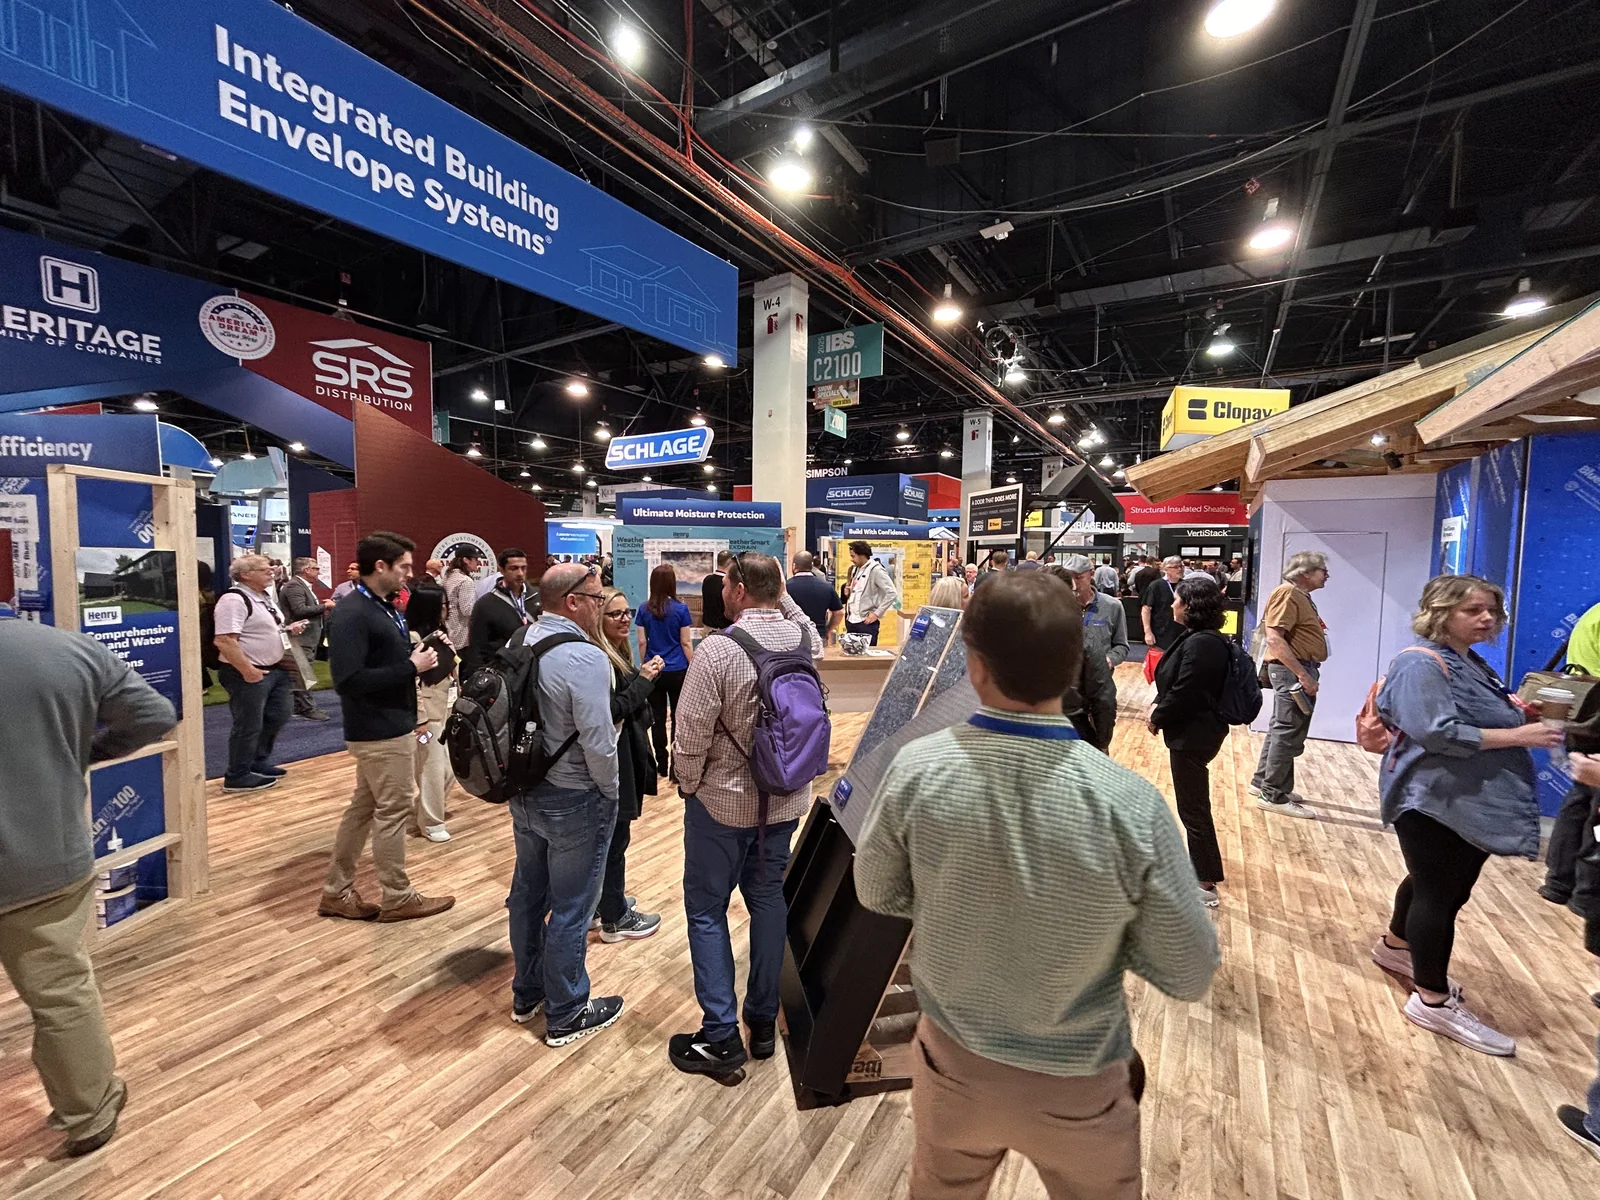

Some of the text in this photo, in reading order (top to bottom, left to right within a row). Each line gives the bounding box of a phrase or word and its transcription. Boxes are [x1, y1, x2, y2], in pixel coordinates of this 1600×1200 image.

[215, 23, 559, 231] Integrated Building
[218, 79, 415, 199] Envelope
[763, 296, 780, 311] W-4
[3, 305, 162, 357] ERITAGE
[208, 314, 267, 333] AMERICAN
[218, 323, 258, 337] DREAM
[826, 330, 856, 353] IBS
[45, 337, 66, 347] OF
[75, 343, 162, 365] COMPANIES
[312, 350, 413, 399] SRS
[813, 351, 862, 382] C2100
[315, 385, 413, 412] DISTRIBUTION
[0, 435, 93, 462] fficiency
[608, 435, 702, 462] SCHLAGE
[806, 467, 848, 479] SIMPSON
[826, 488, 872, 498] SCHLAGE
[632, 507, 766, 520] Ultimate Moisture Protection
[1130, 505, 1236, 514] Structural Insulated Sheathing
[863, 528, 878, 536] With
[1102, 521, 1132, 531] HOUSE
[729, 538, 770, 546] eatherSmart
[88, 611, 118, 620] Henry
[107, 636, 167, 650] and Water
